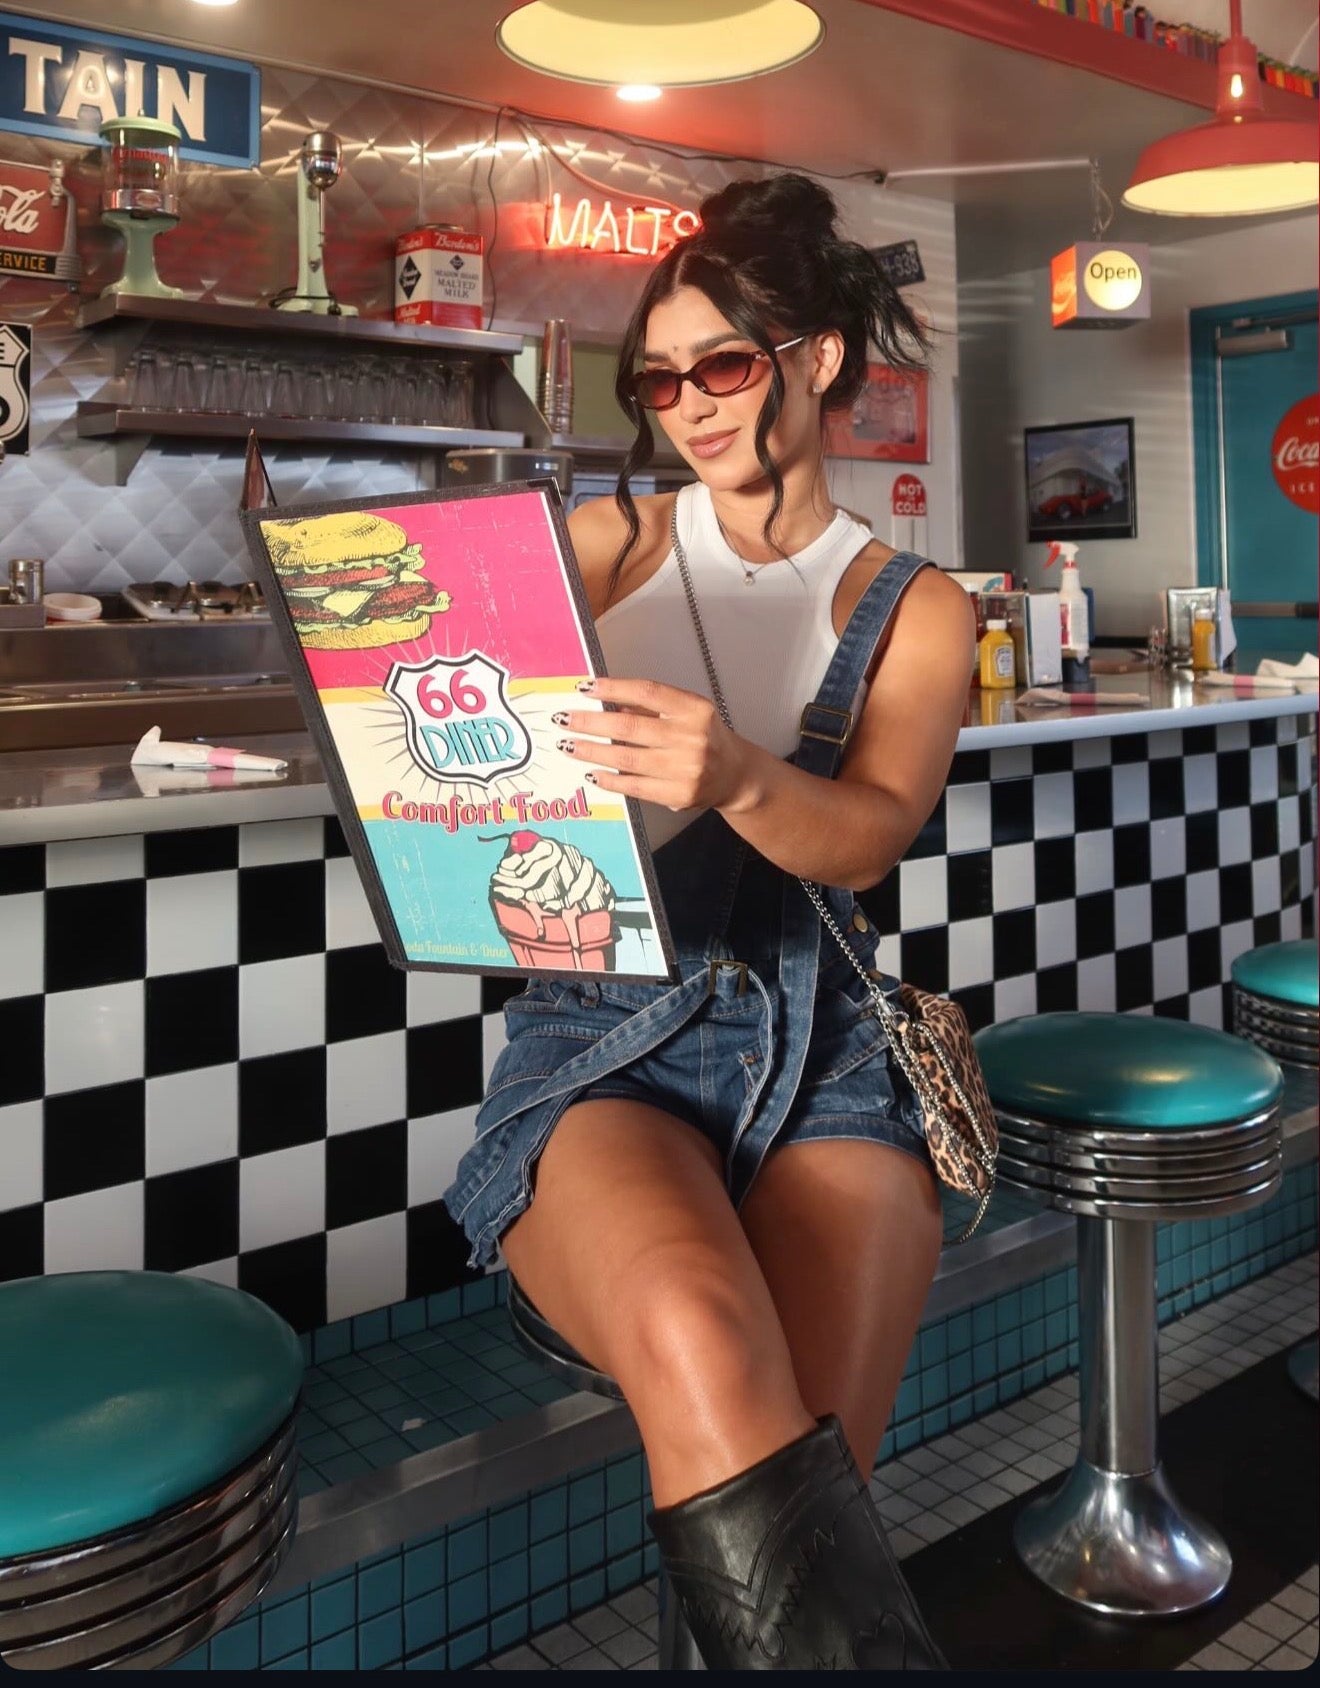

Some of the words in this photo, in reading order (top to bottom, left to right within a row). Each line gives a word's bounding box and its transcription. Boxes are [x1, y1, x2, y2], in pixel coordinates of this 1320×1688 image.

[1090, 262, 1137, 283] Open
[438, 278, 476, 290] MALTED
[444, 288, 470, 299] MILK
[898, 484, 922, 496] HOT
[895, 501, 926, 514] COLD
[417, 668, 487, 719] 66
[419, 716, 522, 769] DINER
[382, 789, 504, 834] Comfort
[510, 786, 592, 824] Food
